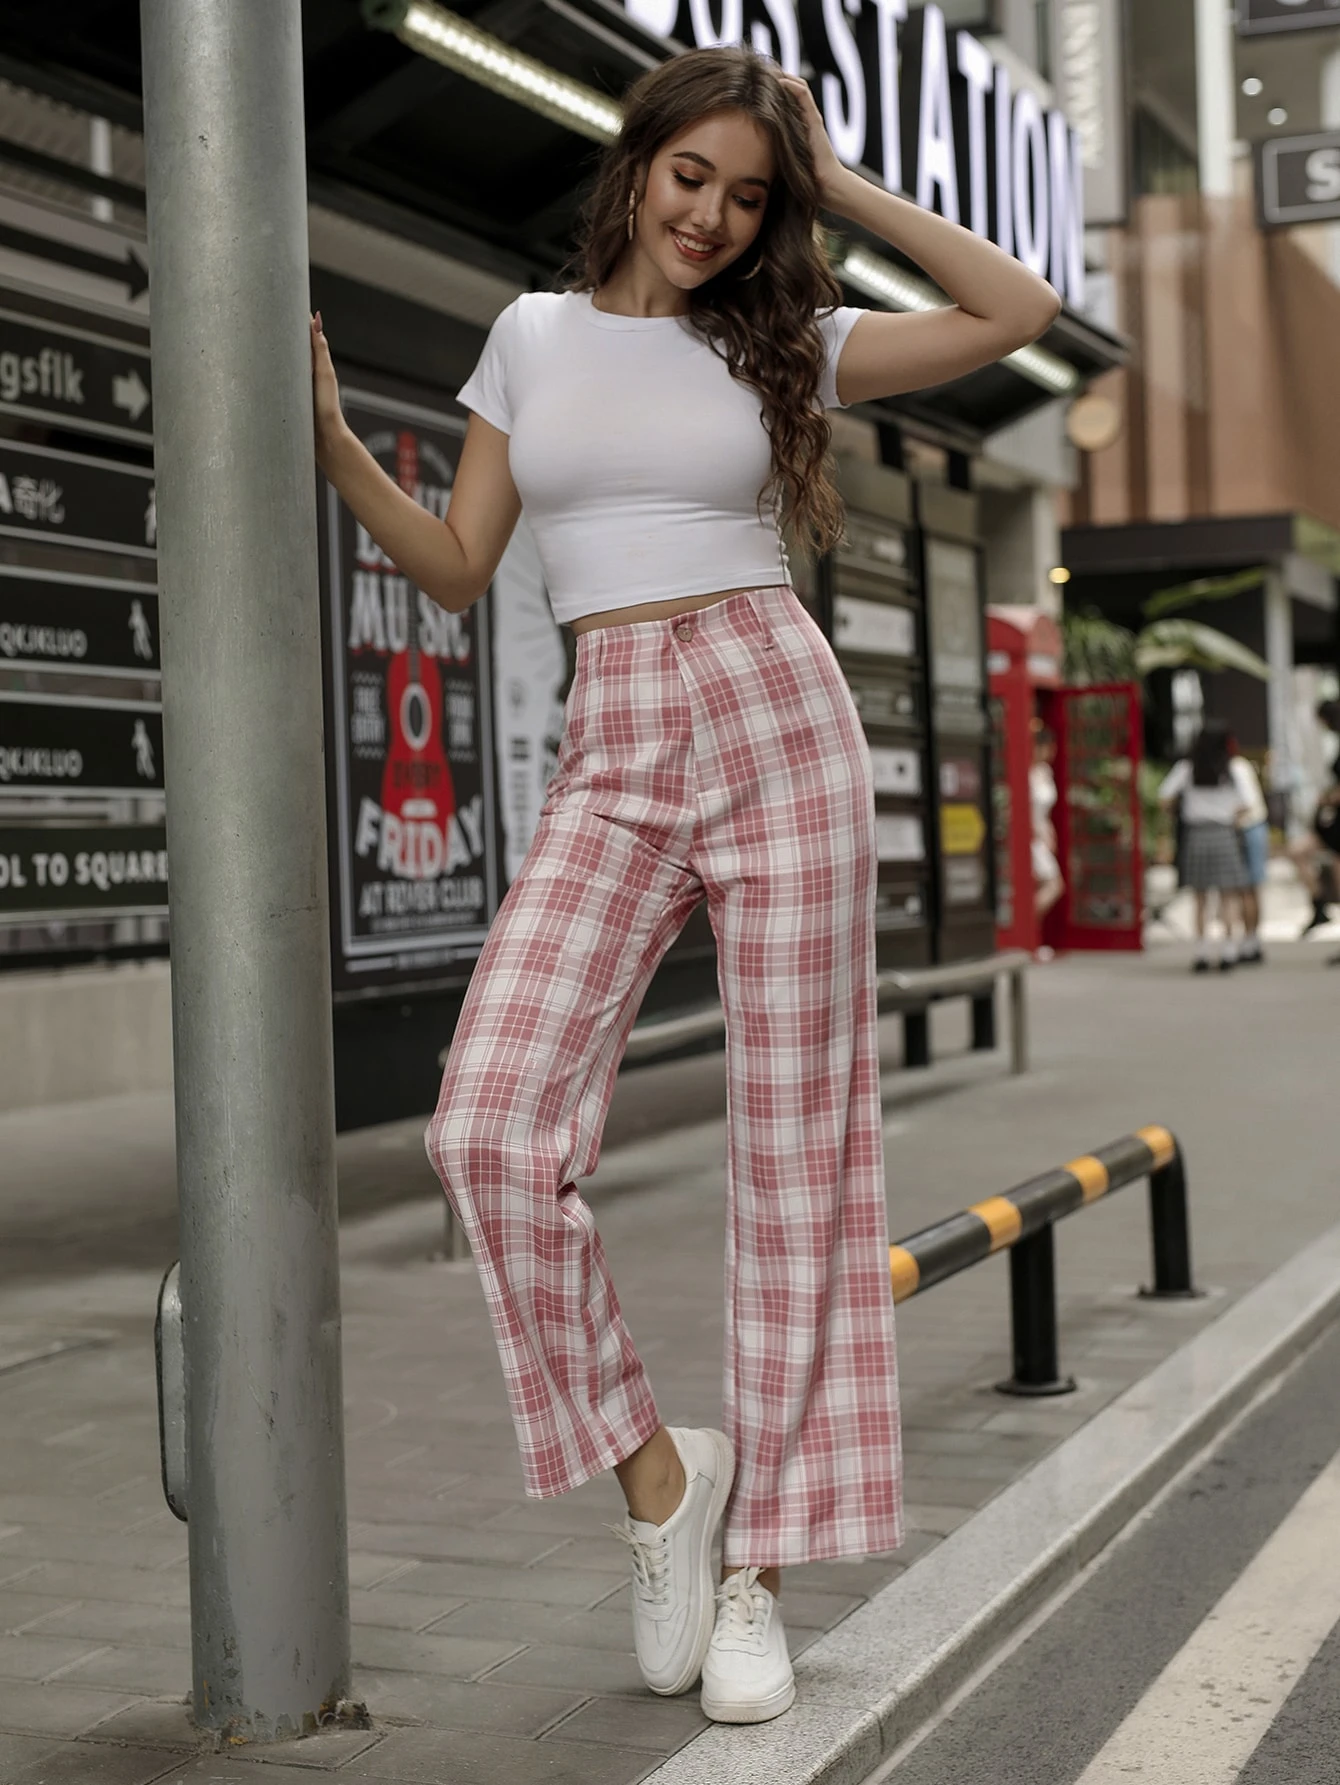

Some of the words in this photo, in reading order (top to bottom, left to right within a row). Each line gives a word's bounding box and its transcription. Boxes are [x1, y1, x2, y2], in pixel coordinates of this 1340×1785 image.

[821, 0, 1085, 311] STATION
[31, 851, 69, 888] TO
[74, 849, 169, 892] SQUARE
[354, 794, 484, 881] FRIDAY
